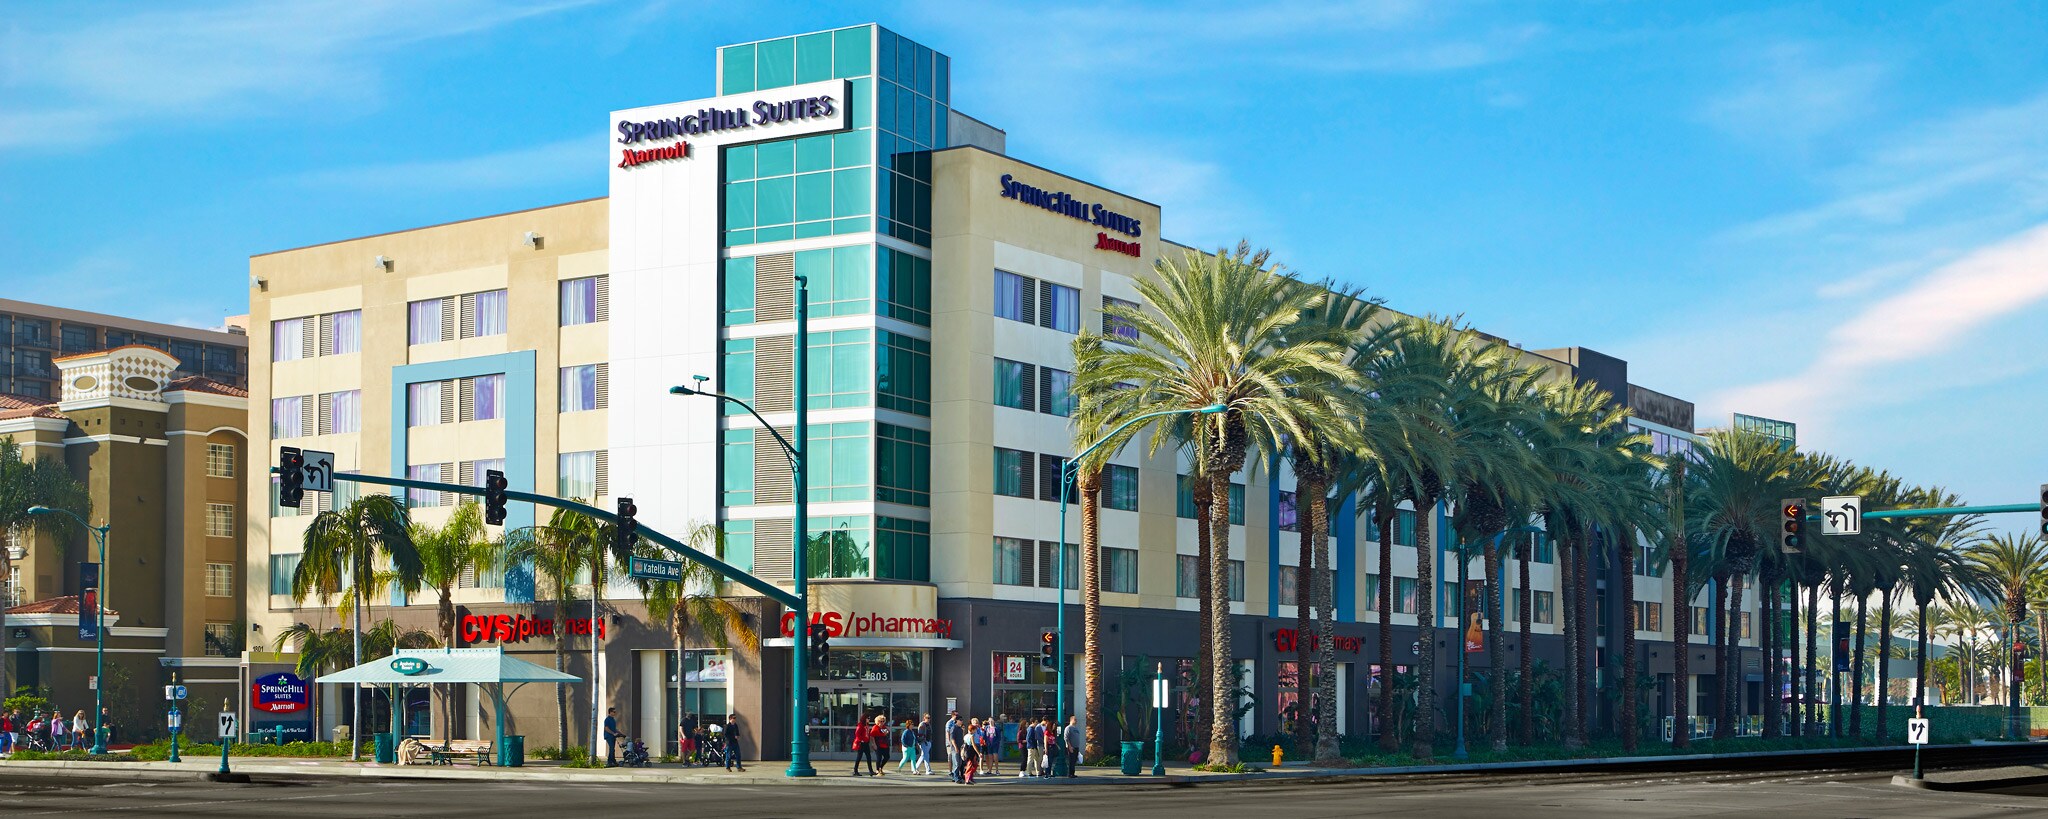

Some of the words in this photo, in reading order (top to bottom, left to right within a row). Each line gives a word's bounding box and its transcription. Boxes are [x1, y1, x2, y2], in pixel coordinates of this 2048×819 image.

[617, 140, 689, 169] Marriott
[1093, 231, 1141, 258] Marriott
[643, 562, 666, 575] Katella
[667, 565, 680, 576] Ave
[463, 613, 606, 642] CVS/phamacy
[1010, 661, 1022, 673] 24
[270, 703, 295, 711] Marriott
